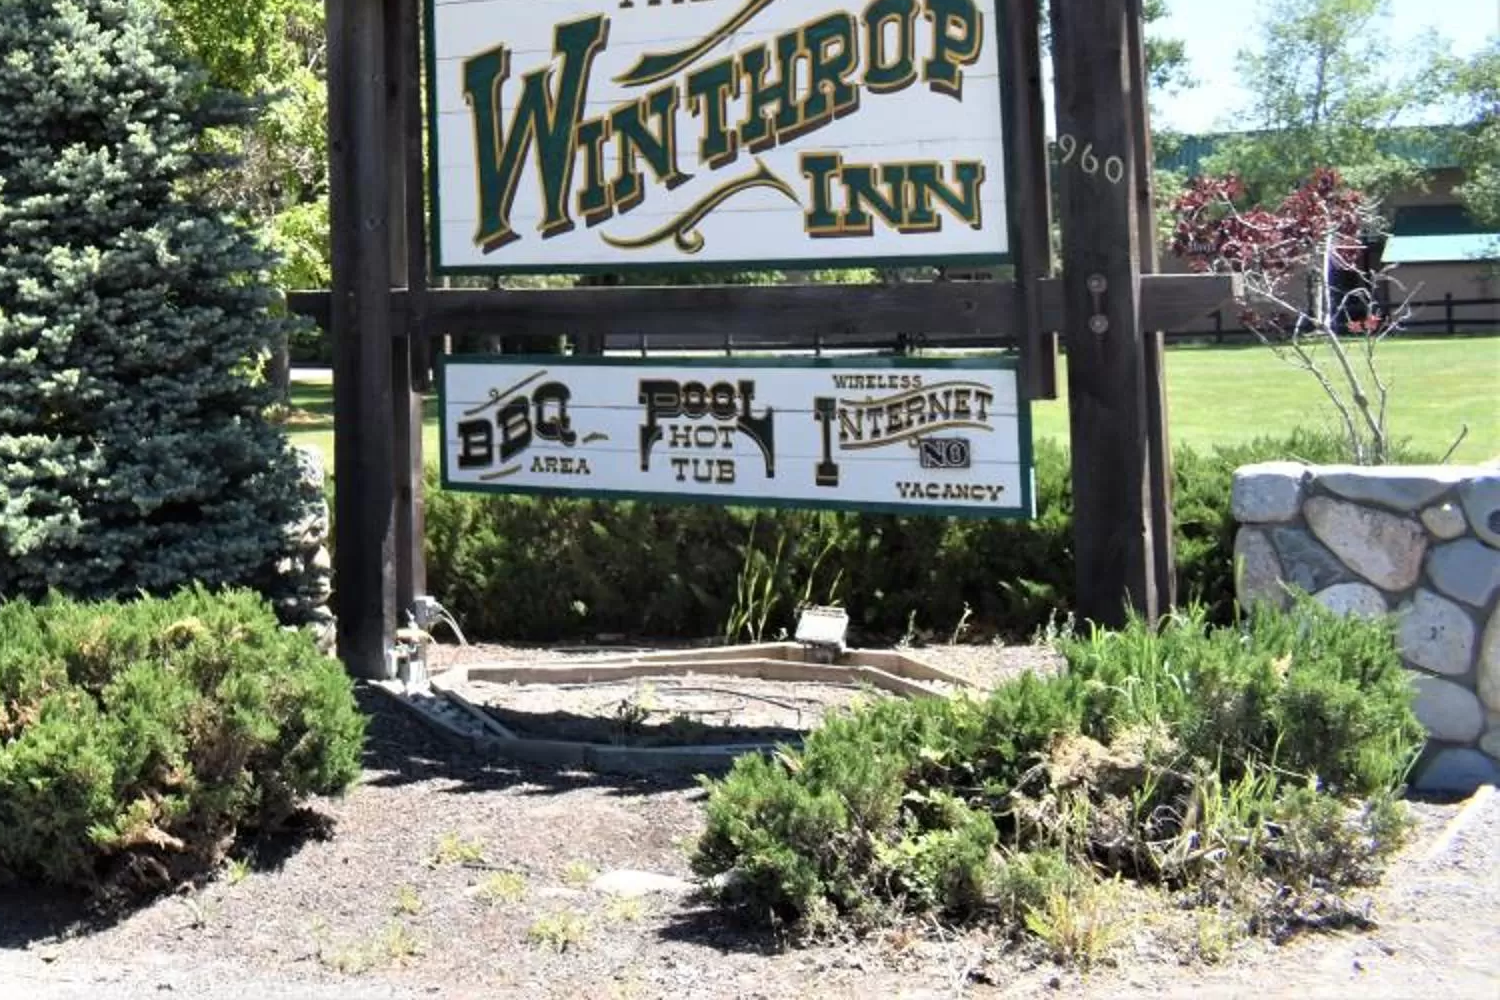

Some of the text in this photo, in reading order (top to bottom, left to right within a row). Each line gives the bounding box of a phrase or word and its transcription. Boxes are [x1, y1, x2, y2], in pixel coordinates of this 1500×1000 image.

[1059, 134, 1124, 184] 960
[800, 151, 985, 238] INN
[832, 374, 923, 390] WIRELESS
[457, 381, 577, 471] BBQ
[638, 378, 775, 479] POOL
[669, 424, 737, 449] HOT
[814, 387, 994, 487] INTERNET
[530, 455, 591, 475] AREA
[923, 440, 968, 467] NO
[671, 458, 735, 484] TUB
[896, 482, 1005, 501] VACANCY
